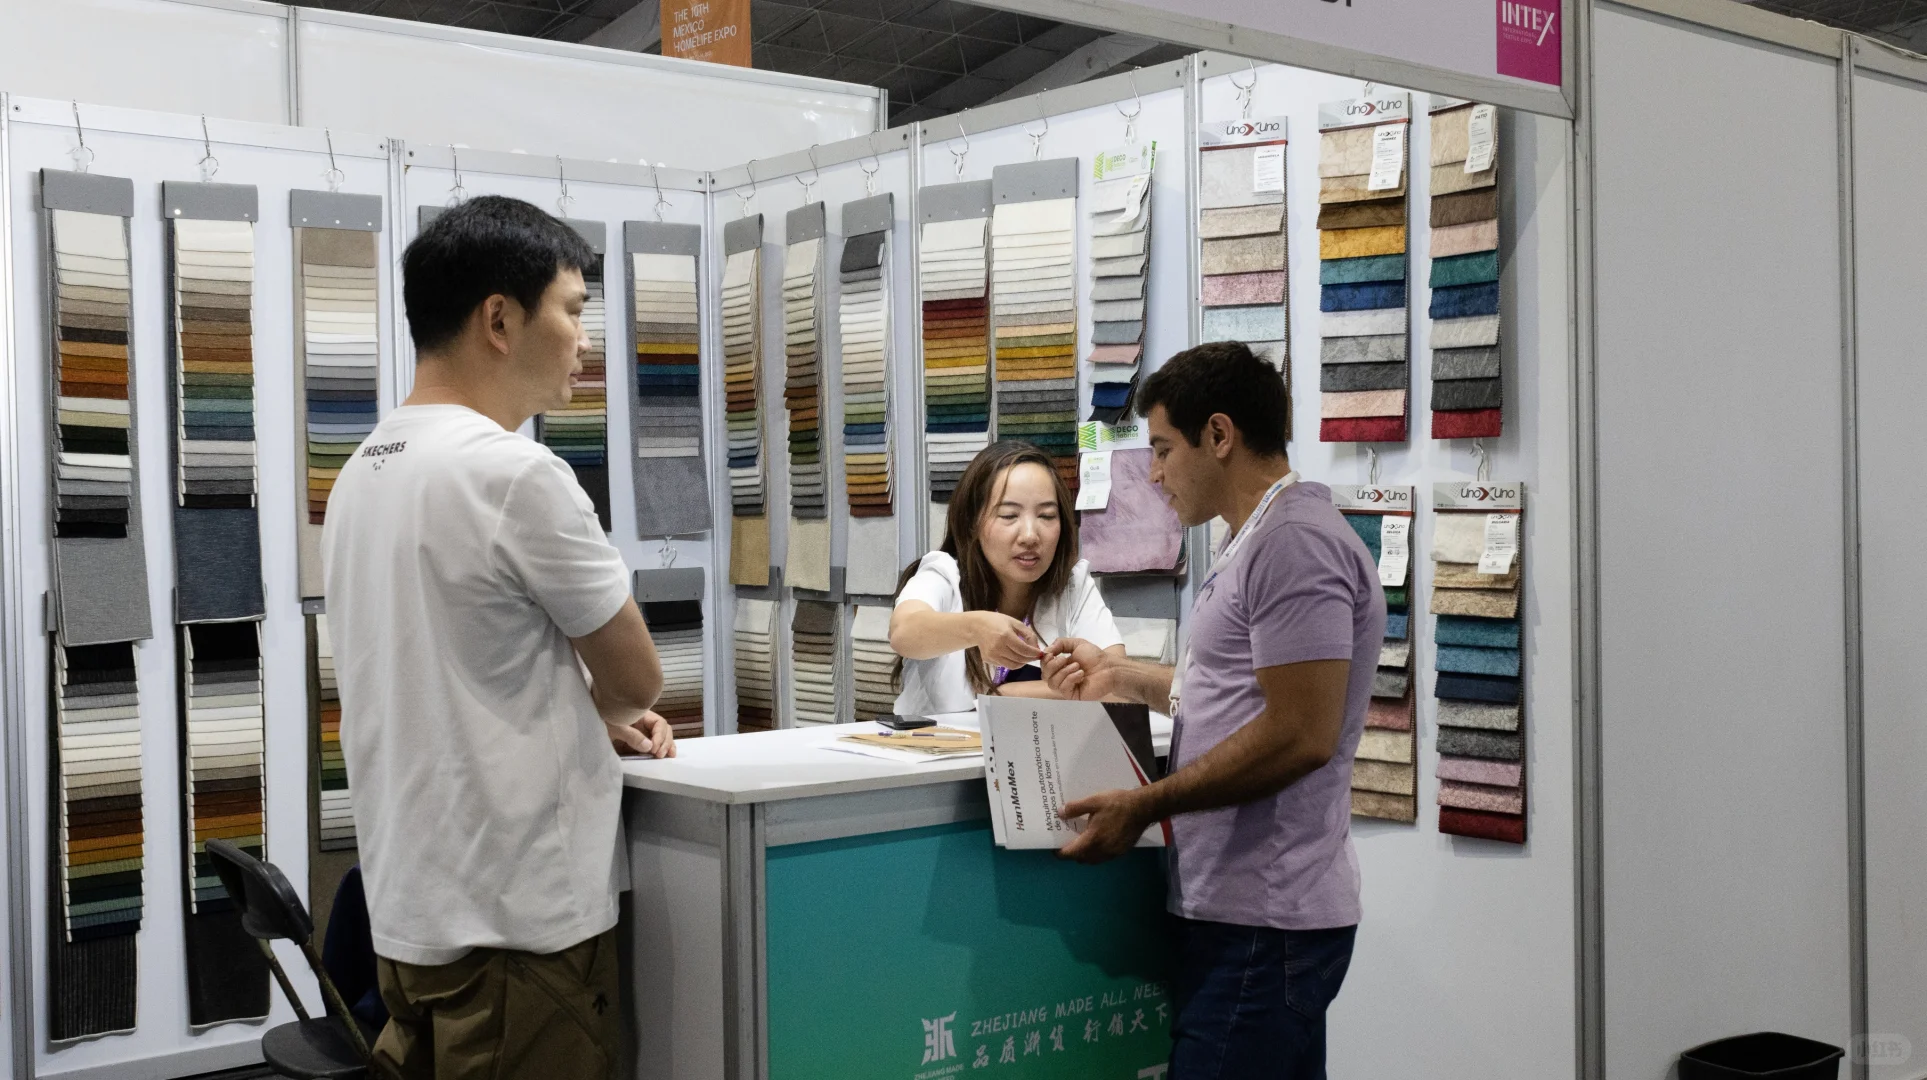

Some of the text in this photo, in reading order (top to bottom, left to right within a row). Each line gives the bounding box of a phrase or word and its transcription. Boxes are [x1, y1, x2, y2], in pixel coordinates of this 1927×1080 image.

[674, 3, 710, 23] THE 10TH
[1502, 0, 1555, 46] INTEX
[673, 20, 705, 38] MEXICO
[673, 25, 737, 53] HOMELIFE EXPO
[1116, 425, 1139, 433] DECO
[361, 440, 407, 458] SKECHERS
[1031, 711, 1054, 831] Máquina automática de corte
[1044, 759, 1053, 779] láser
[1007, 760, 1025, 831] HanMaMex
[1047, 781, 1057, 795] por
[1049, 796, 1060, 819] tubos
[1053, 820, 1062, 831] de
[971, 1006, 1047, 1037] ZHEJIANG
[1055, 996, 1094, 1019] MADE
[1100, 989, 1127, 1008] ALL
